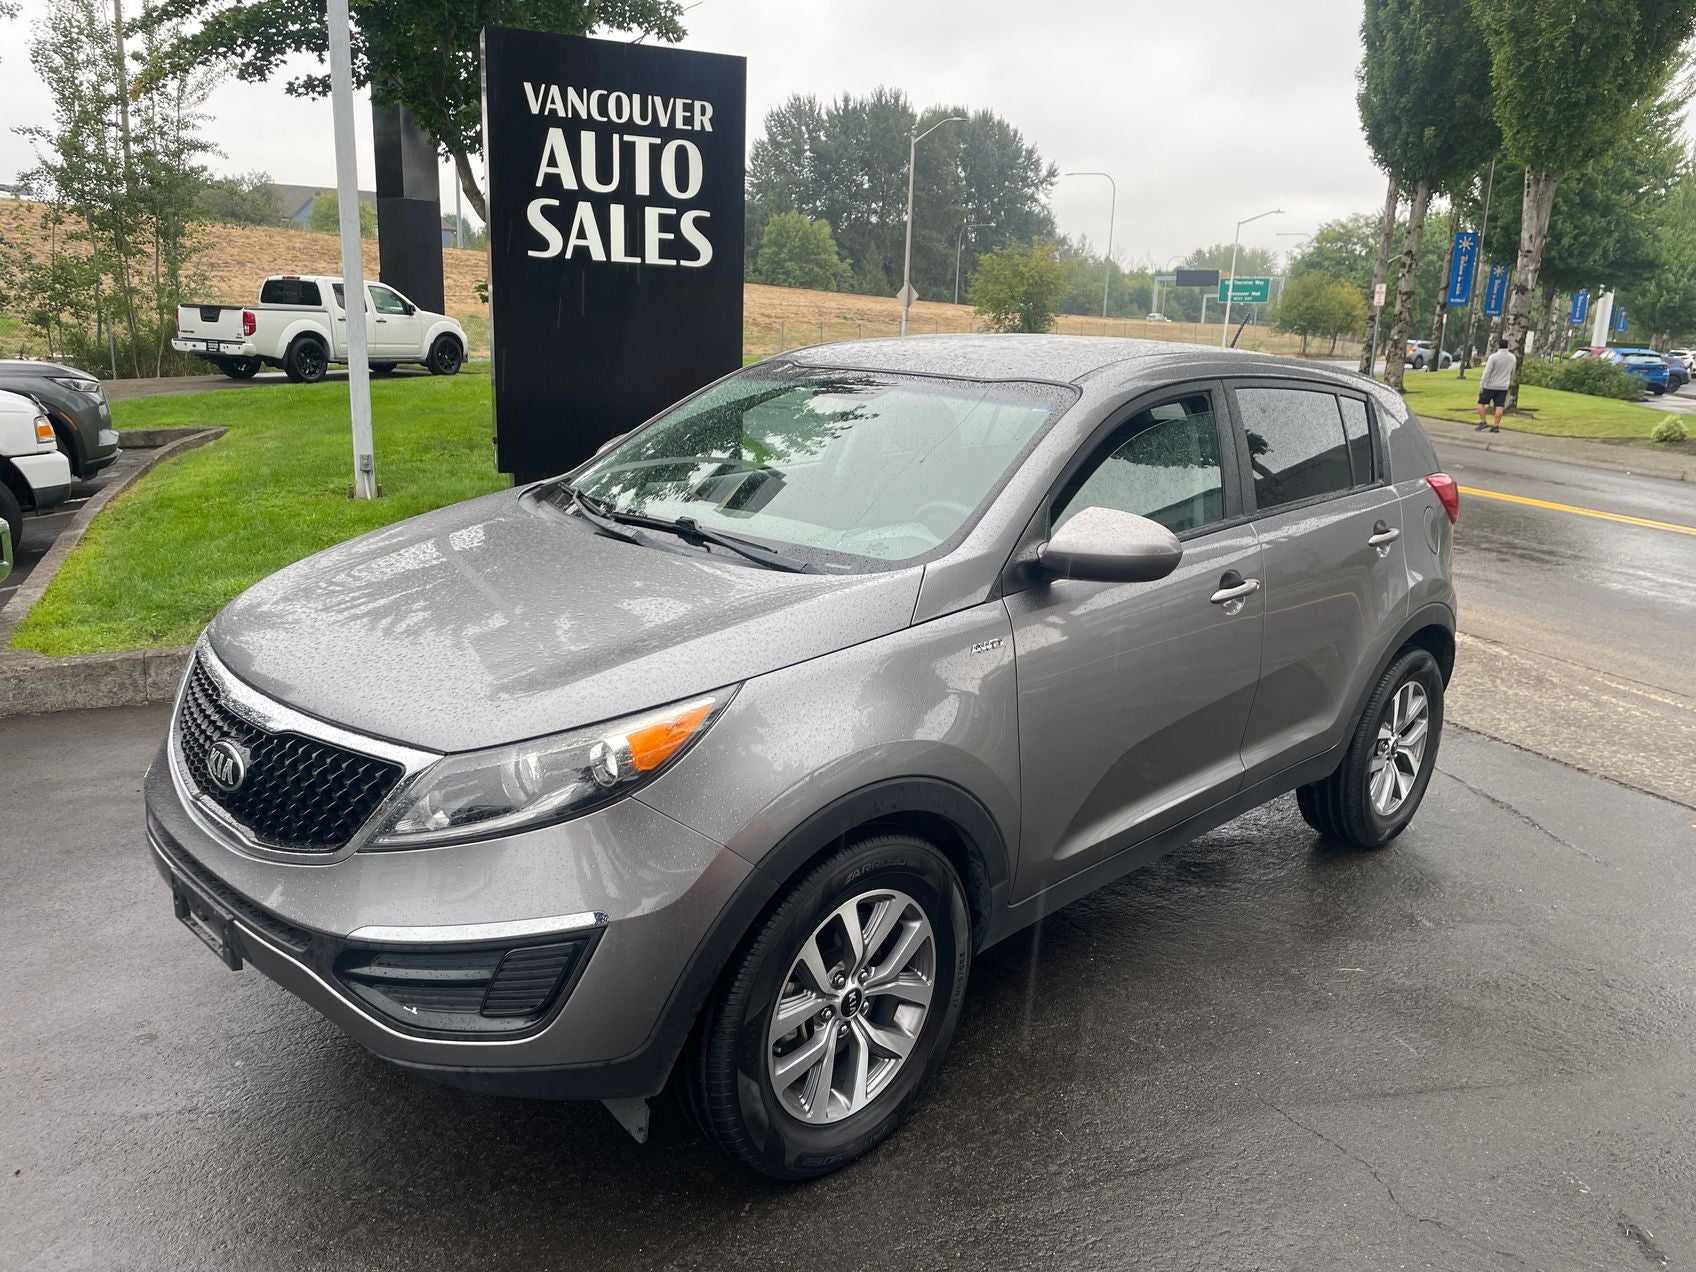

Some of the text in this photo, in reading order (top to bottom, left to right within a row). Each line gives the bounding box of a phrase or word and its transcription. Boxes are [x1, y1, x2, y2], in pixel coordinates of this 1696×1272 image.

[523, 81, 714, 132] VANCOUVER
[535, 127, 703, 200] AUTO
[526, 197, 713, 268] SALES
[970, 638, 1004, 656] AWD
[210, 747, 234, 785] KIA
[848, 990, 857, 1016] KIA
